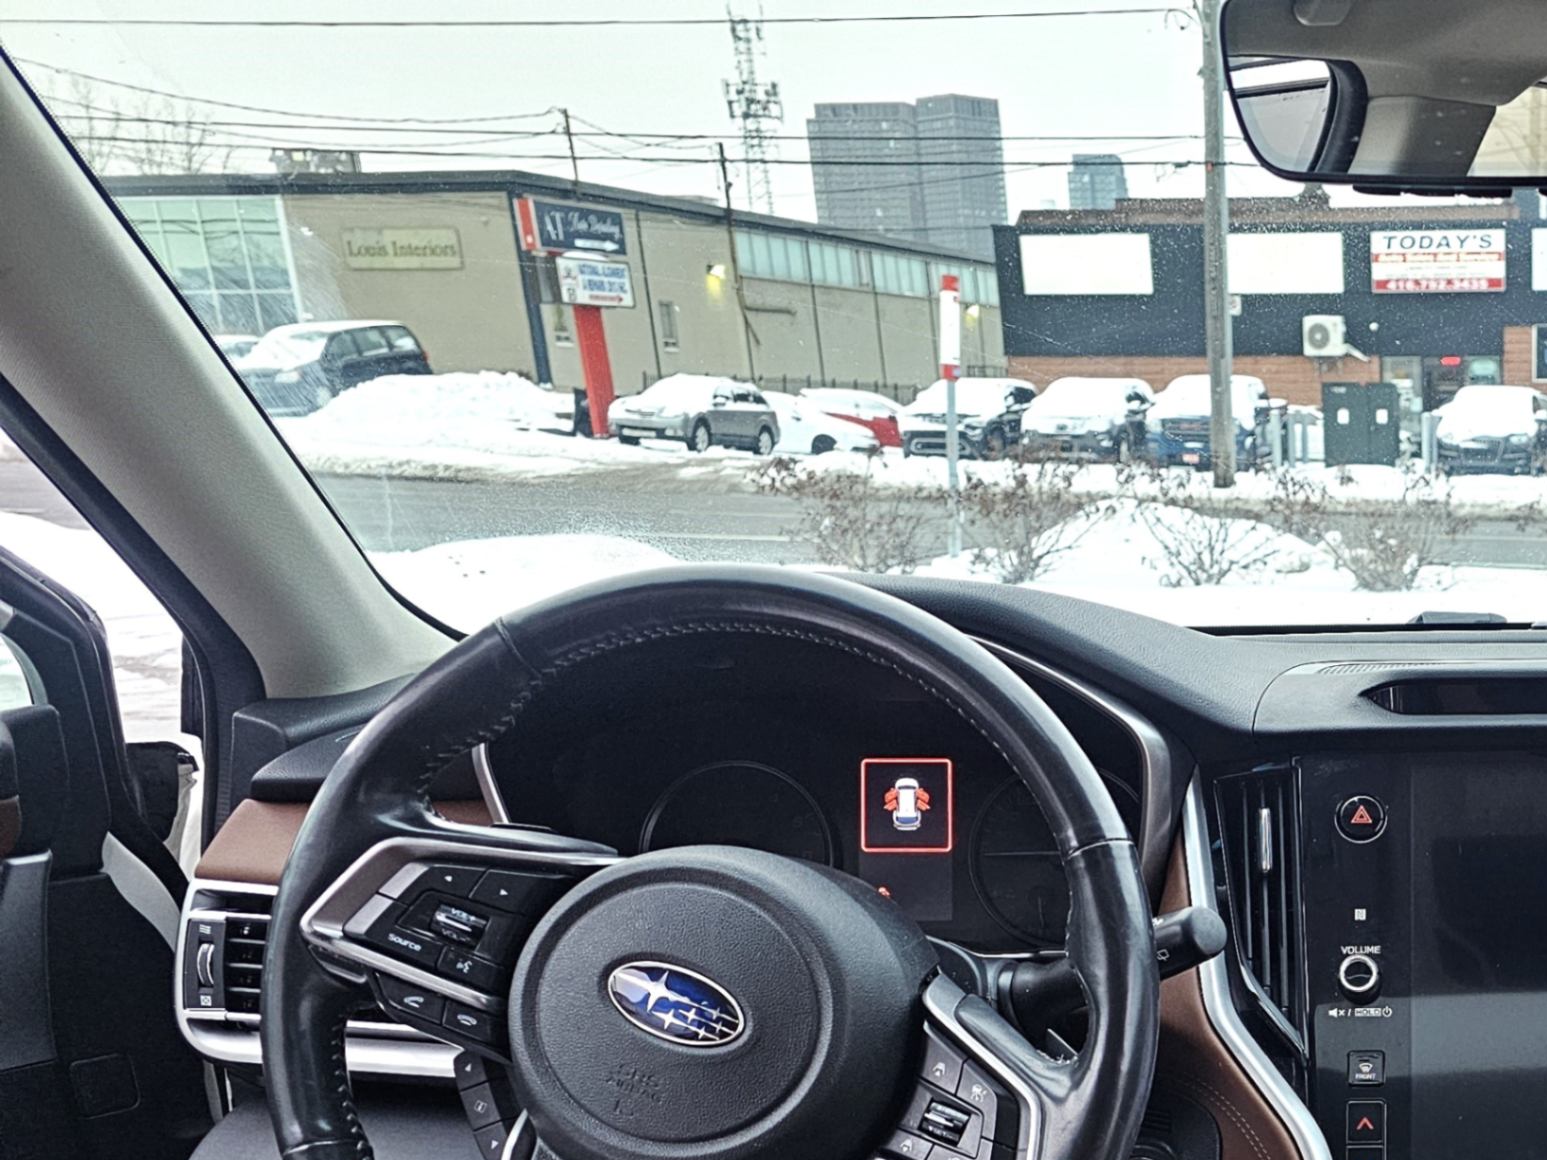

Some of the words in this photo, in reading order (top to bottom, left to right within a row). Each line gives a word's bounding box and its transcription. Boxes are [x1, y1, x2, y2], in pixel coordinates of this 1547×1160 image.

[346, 240, 388, 257] Louis
[391, 240, 457, 257] Interiors
[1383, 235, 1492, 249] TODAY'S
[386, 932, 423, 952] Source
[1340, 946, 1382, 954] VOLUME
[1355, 1008, 1381, 1017] HOLD
